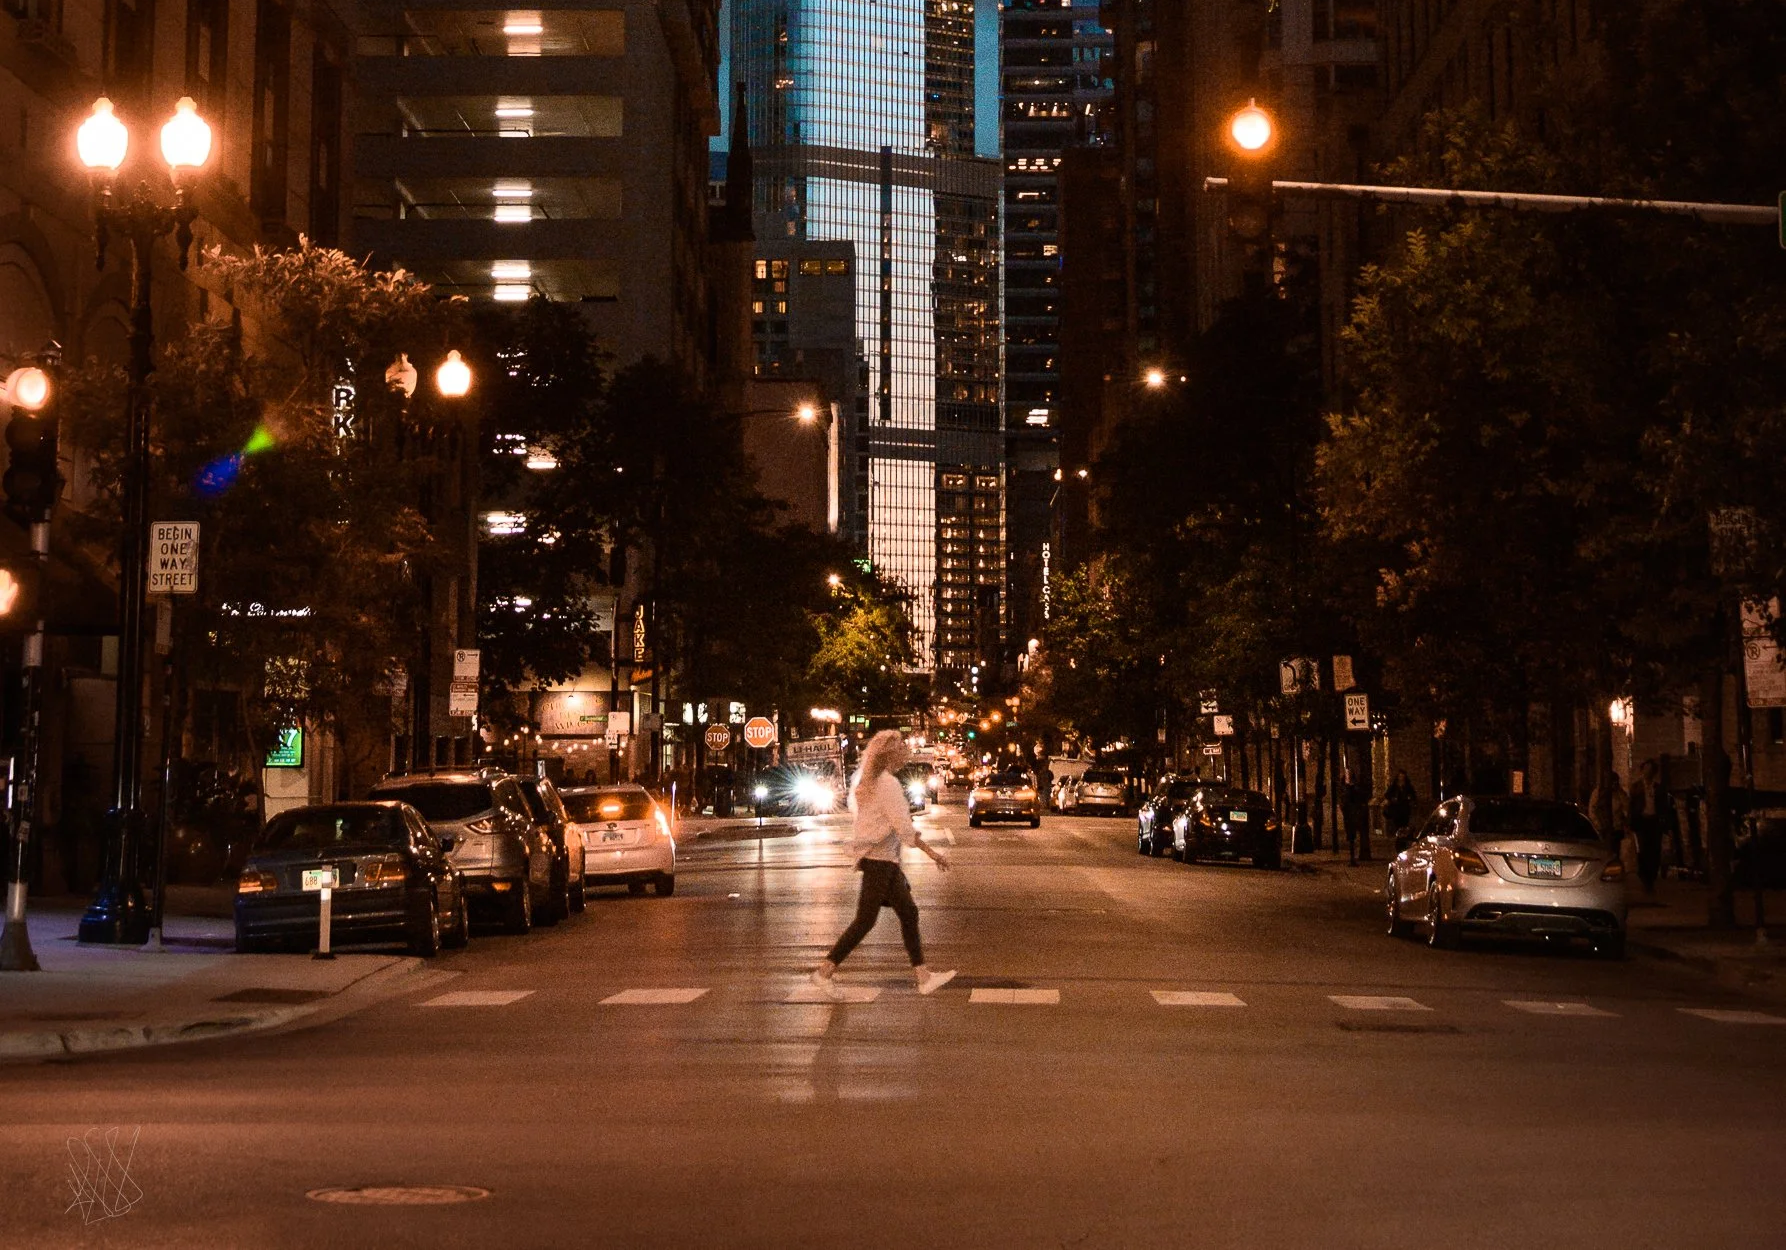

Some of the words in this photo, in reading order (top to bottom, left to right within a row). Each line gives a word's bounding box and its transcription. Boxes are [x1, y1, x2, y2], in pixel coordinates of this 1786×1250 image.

[158, 527, 192, 540] BEGIN
[160, 542, 187, 555] ONE
[160, 557, 187, 570] WAY
[1041, 542, 1051, 585] HOTEL
[151, 572, 193, 586] STREET
[633, 604, 646, 663] JAKE
[1347, 697, 1365, 706] ONE
[1347, 707, 1365, 716] WAY
[707, 732, 729, 743] STOP
[747, 726, 771, 739] STOP
